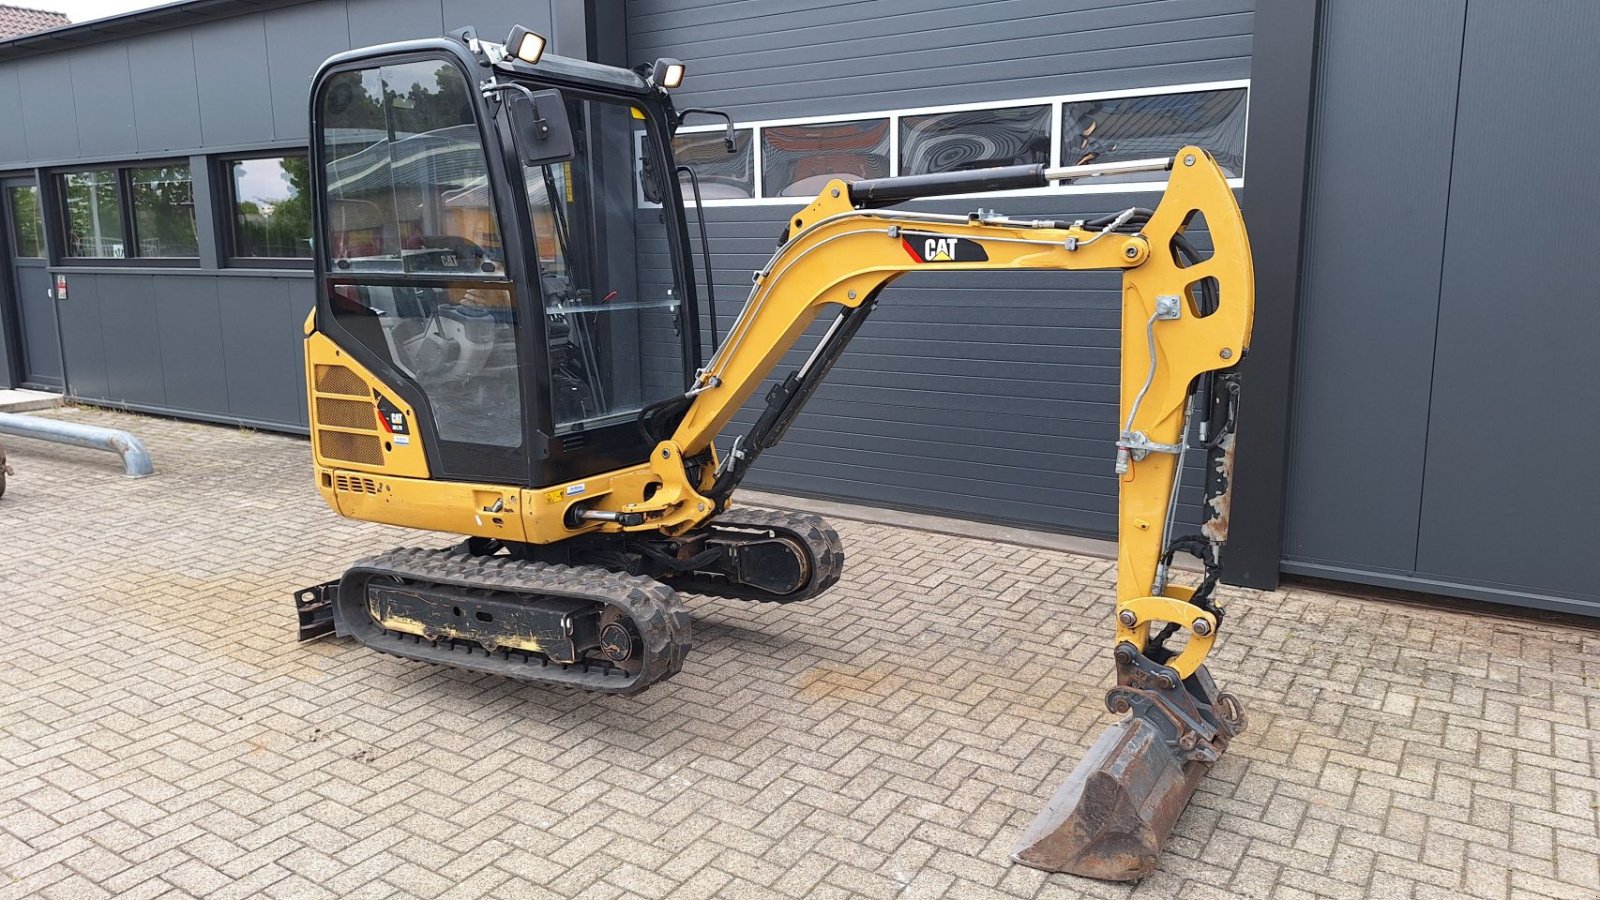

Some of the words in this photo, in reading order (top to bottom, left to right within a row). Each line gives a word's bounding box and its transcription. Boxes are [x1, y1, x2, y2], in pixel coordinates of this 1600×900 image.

[924, 238, 958, 261] CAT
[440, 255, 458, 267] CAT
[391, 412, 403, 424] CAT
